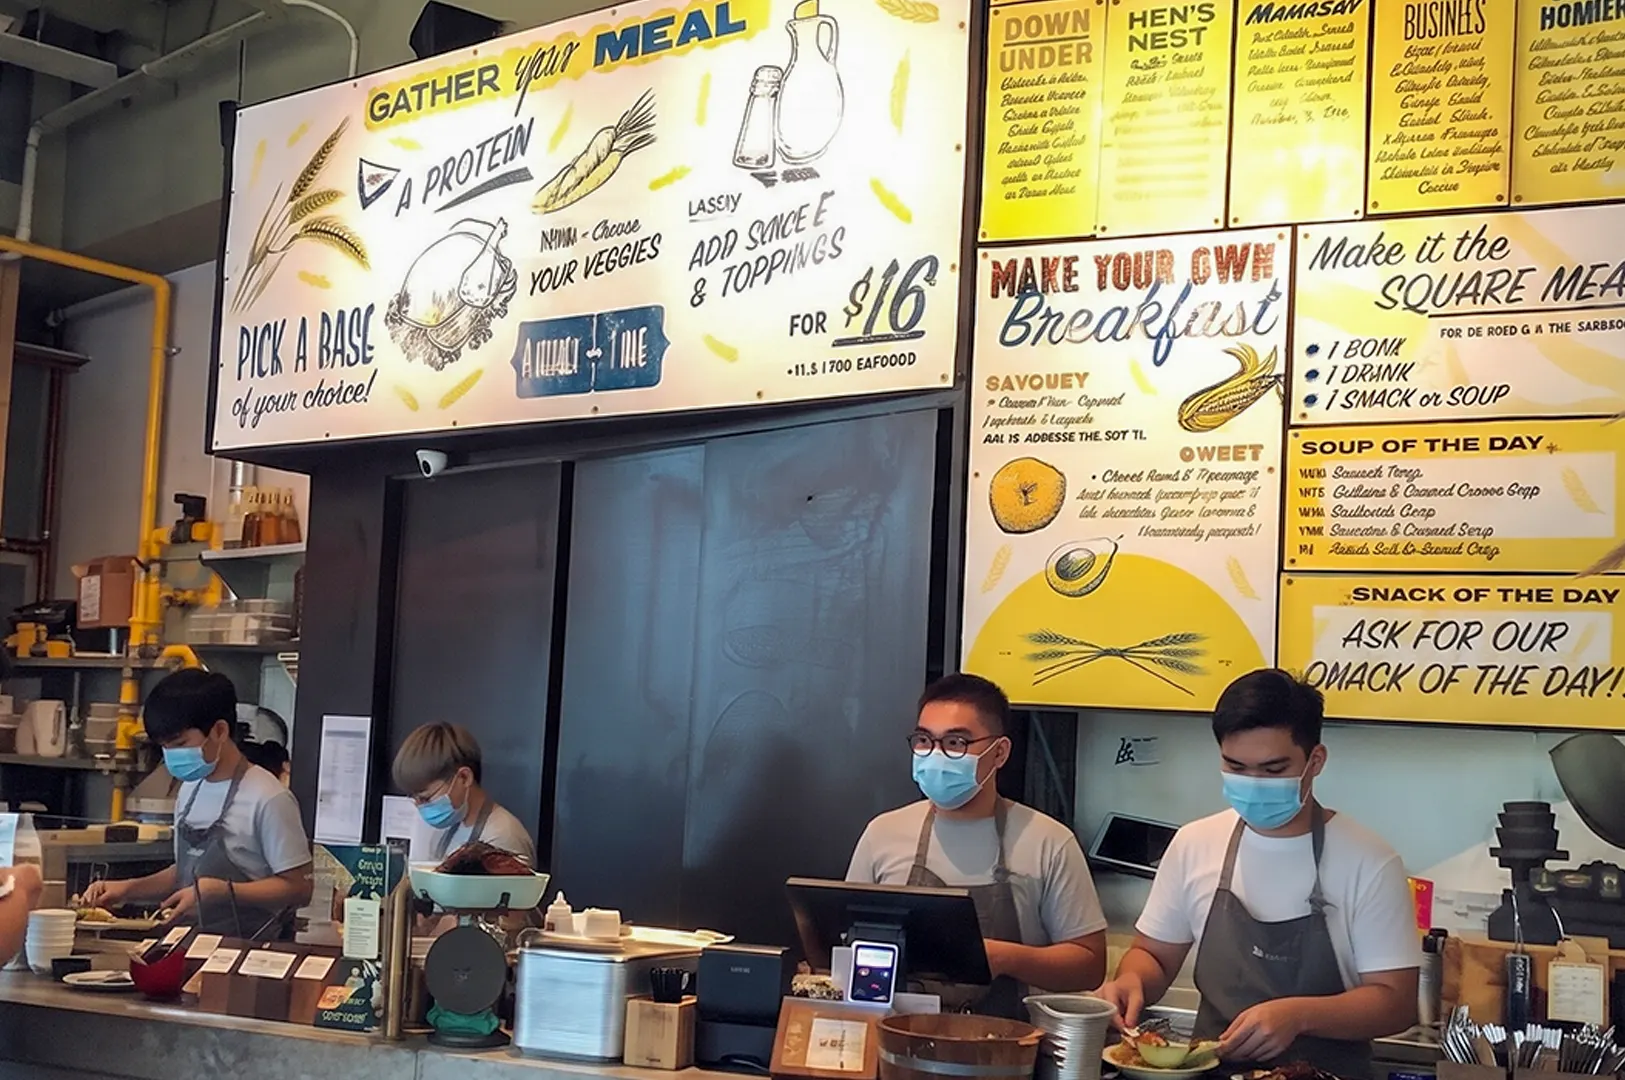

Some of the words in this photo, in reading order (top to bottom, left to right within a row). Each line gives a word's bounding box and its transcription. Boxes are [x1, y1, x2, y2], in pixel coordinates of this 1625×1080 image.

[1005, 8, 1090, 41] DOWN
[1129, 3, 1216, 30] HEN'S
[1128, 26, 1208, 52] NEST
[369, 63, 501, 124] GATHER
[594, 1, 747, 67] MEAL
[1000, 42, 1093, 73] UNDER
[395, 182, 413, 217] A
[422, 117, 535, 204] PROTEIN
[1308, 231, 1406, 271] Make
[1416, 231, 1447, 264] it
[1453, 223, 1511, 263] the
[529, 259, 578, 296] YOUR
[584, 232, 663, 279] VEGGIES
[990, 256, 1080, 298] MAKE
[1093, 249, 1175, 291] YOUR
[690, 277, 707, 308] &
[789, 311, 827, 336] FOR
[842, 255, 939, 337] $16
[1374, 267, 1538, 316] SQUARE
[999, 278, 1283, 367] Breakfast
[1440, 328, 1463, 338] FOR
[1548, 322, 1571, 333] THE
[237, 318, 287, 381] PICK
[294, 316, 307, 373] A
[318, 303, 375, 370] BASE
[232, 387, 253, 429] of
[252, 390, 298, 429] your
[302, 368, 379, 410] choice!
[1340, 388, 1418, 409] SMACK
[1419, 393, 1442, 408] or
[1446, 384, 1511, 407] SOUP
[1301, 440, 1373, 455] SOUP
[1381, 440, 1417, 453] OF
[1424, 437, 1480, 452] THE
[1489, 435, 1544, 451] DAY
[1389, 483, 1400, 498] &
[1352, 588, 1447, 603] SNACK
[1453, 588, 1491, 603] OF
[1497, 588, 1554, 603] THE
[1562, 588, 1620, 604] DAY
[1342, 619, 1411, 649] ASK
[1413, 620, 1484, 651] FOR
[1492, 621, 1569, 652] OUR
[1419, 663, 1468, 695] OF
[1472, 664, 1539, 696] THE
